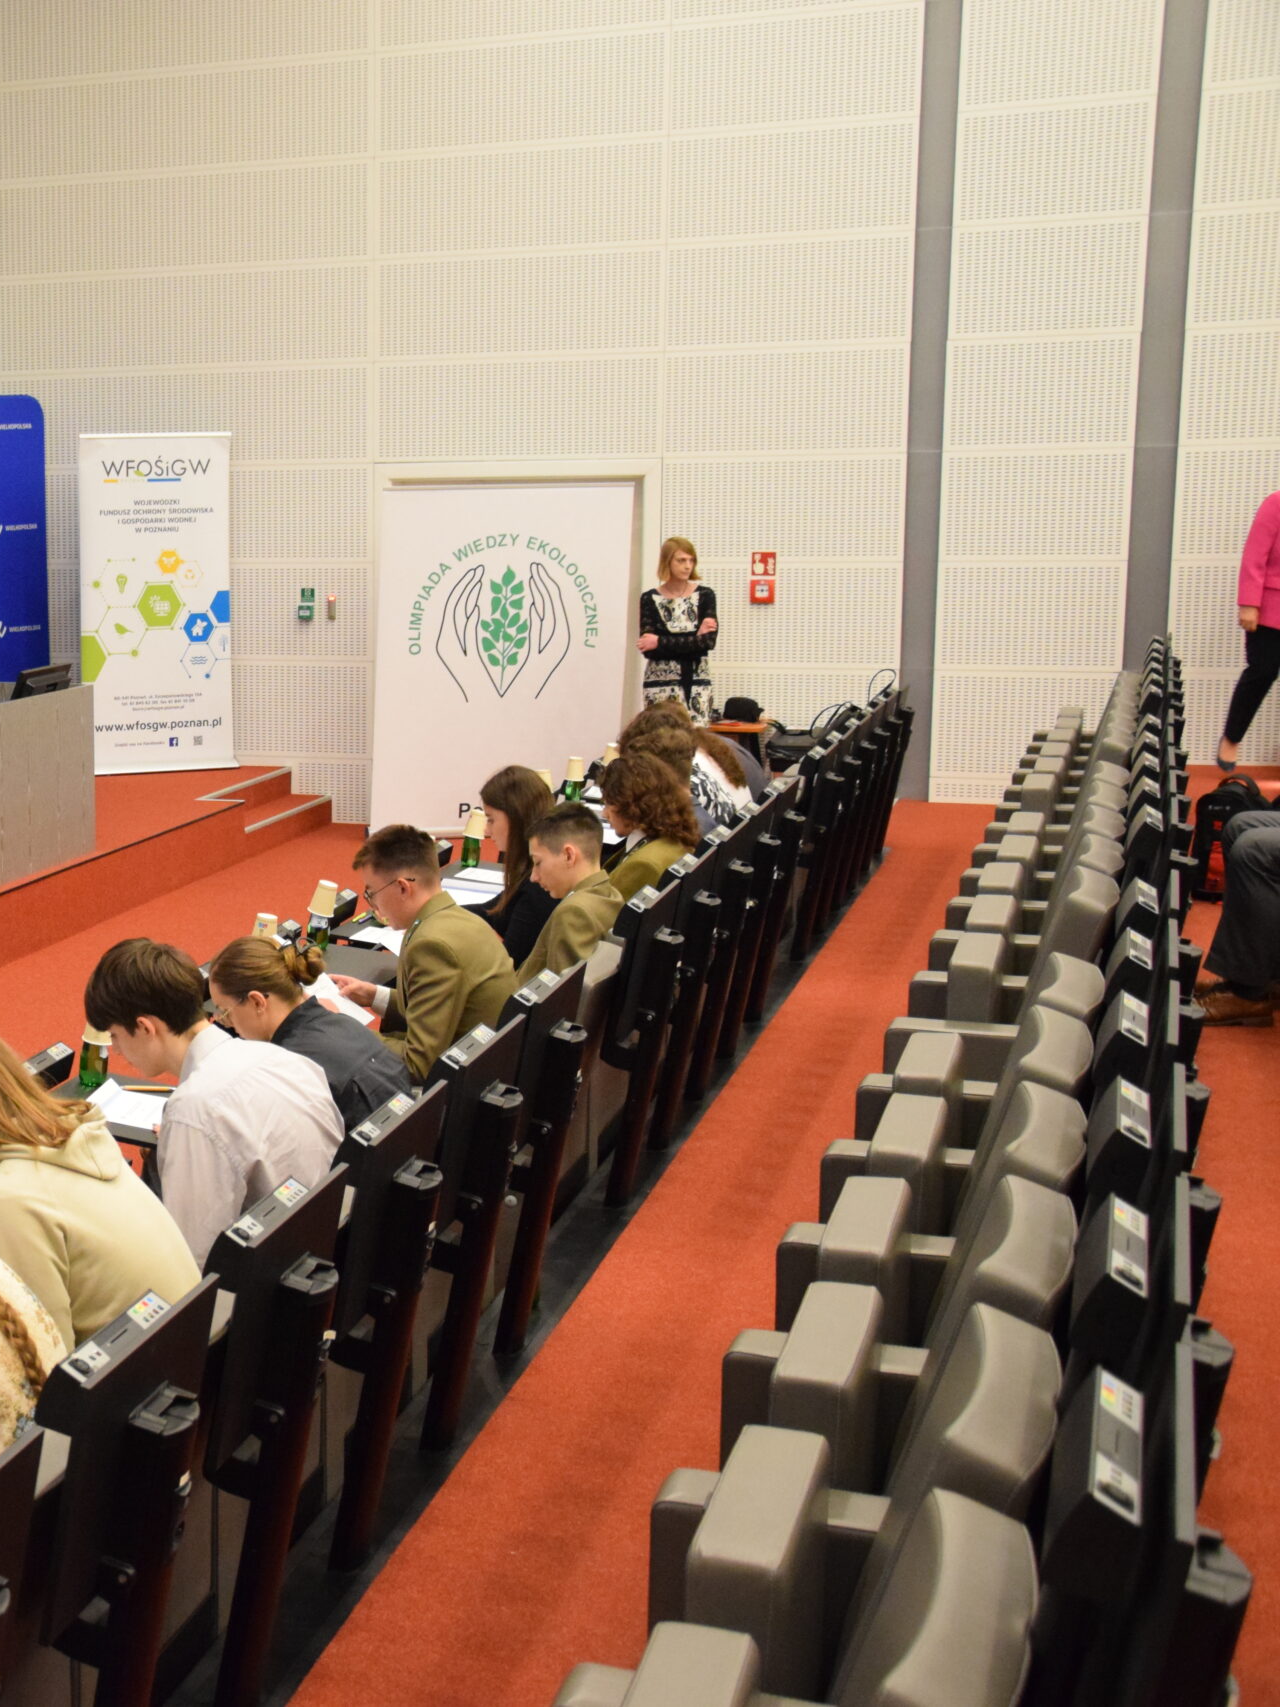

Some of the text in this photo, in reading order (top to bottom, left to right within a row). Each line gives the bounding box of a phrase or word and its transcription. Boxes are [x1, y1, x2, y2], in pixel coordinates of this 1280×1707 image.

[408, 533, 599, 656] OLIMPIADA WIEDZY EKOLOGICZNEJ
[94, 717, 222, 732] www.wfosgw.poznan.pl
